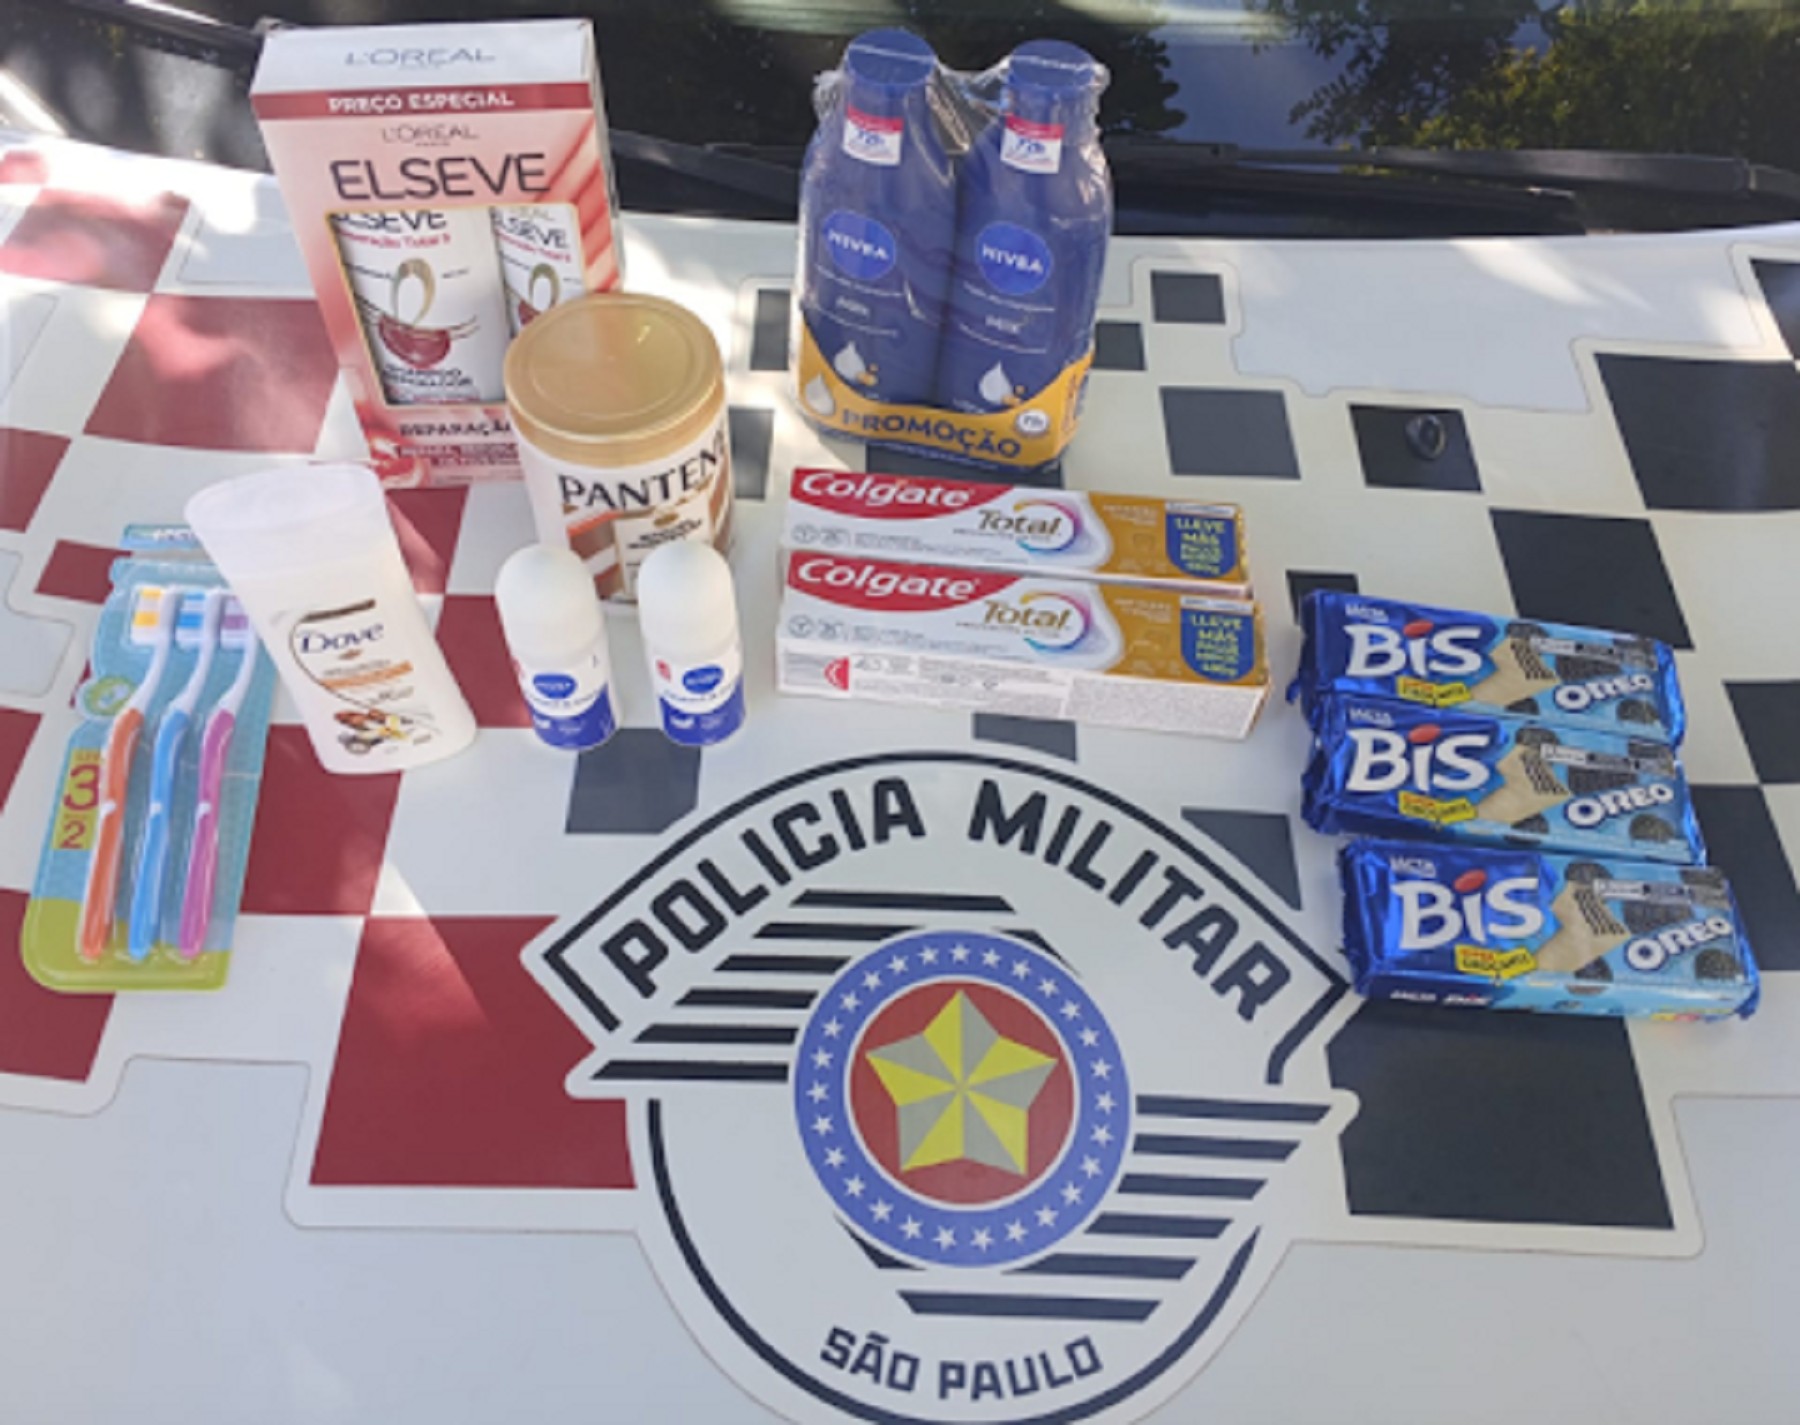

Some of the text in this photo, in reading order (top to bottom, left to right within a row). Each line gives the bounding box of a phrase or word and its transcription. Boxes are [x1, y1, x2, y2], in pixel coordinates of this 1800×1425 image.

[328, 91, 515, 113] PREÇO ESPECIAL
[330, 153, 552, 200] ELSEVE
[827, 231, 890, 260] NIVEA
[982, 244, 1044, 274] NIVEA
[401, 419, 512, 436] REPARAÇÃ
[842, 408, 1022, 459] PROMOÇÃO
[801, 472, 971, 507] Colgate
[978, 508, 1063, 535] Total
[799, 559, 975, 599] Colgate
[984, 600, 1071, 629] Total
[299, 623, 384, 653] Dove
[63, 763, 101, 812] 3
[60, 819, 86, 850] 2
[967, 779, 1292, 1022] MILITAR
[1627, 916, 1733, 970] OREO
[820, 1325, 1103, 1402] SÃO PAULO
